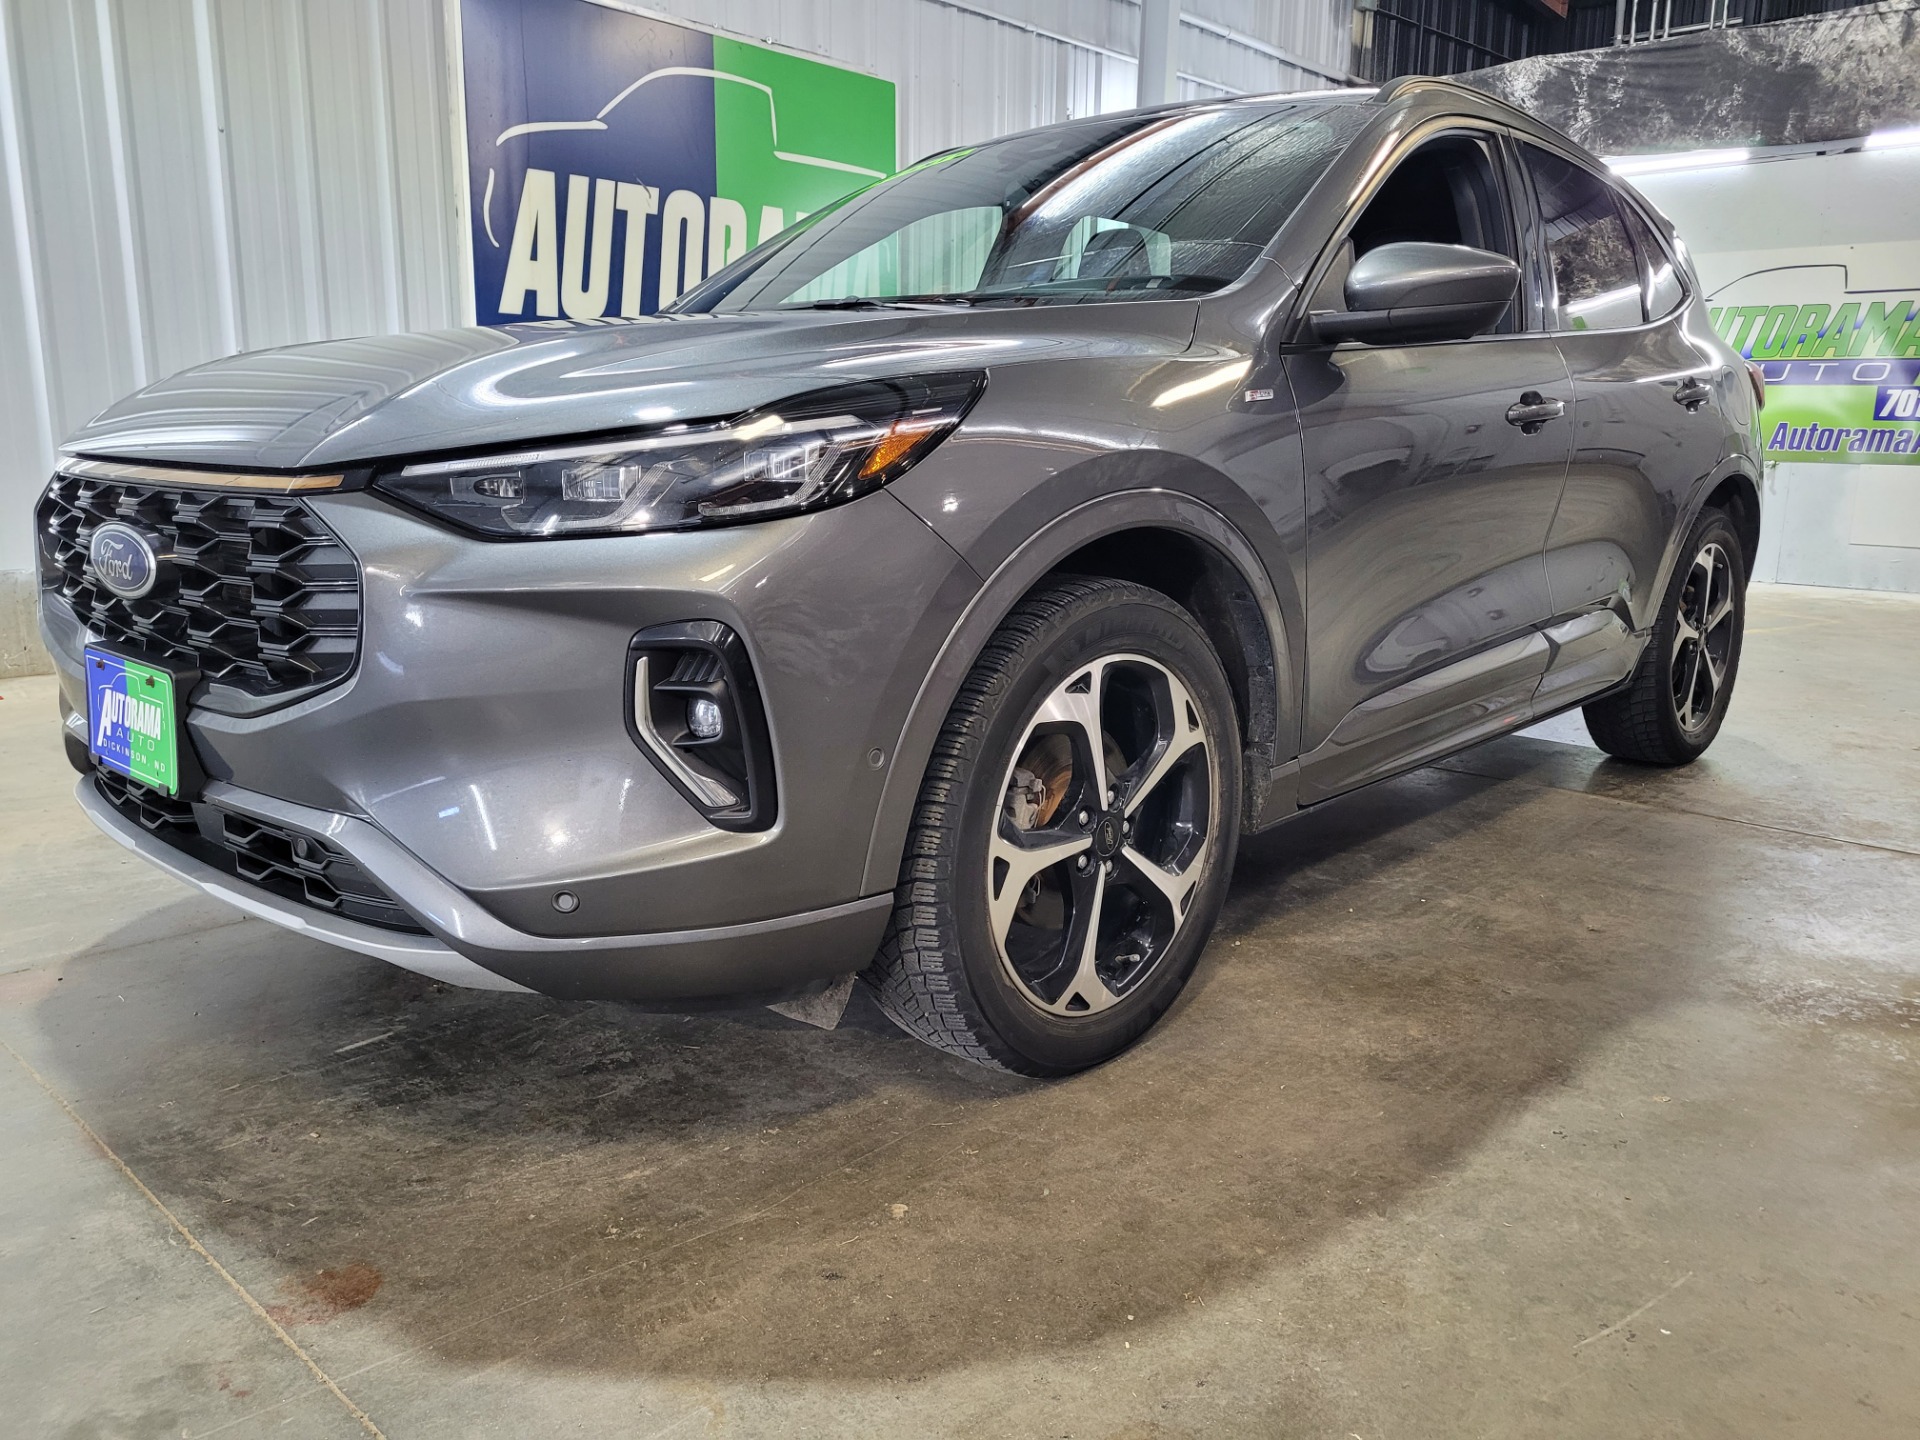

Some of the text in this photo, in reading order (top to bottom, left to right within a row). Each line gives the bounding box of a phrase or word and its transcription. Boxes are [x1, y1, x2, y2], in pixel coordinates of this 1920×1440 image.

[1706, 300, 1920, 358] UTORAM
[1763, 362, 1890, 382] UTO
[1878, 389, 1920, 418] 70
[1767, 422, 1920, 454] Autorama
[99, 538, 133, 581] Ford
[97, 688, 161, 746] AUTORAMA
[115, 726, 155, 752] AUTO
[154, 760, 166, 773] ND
